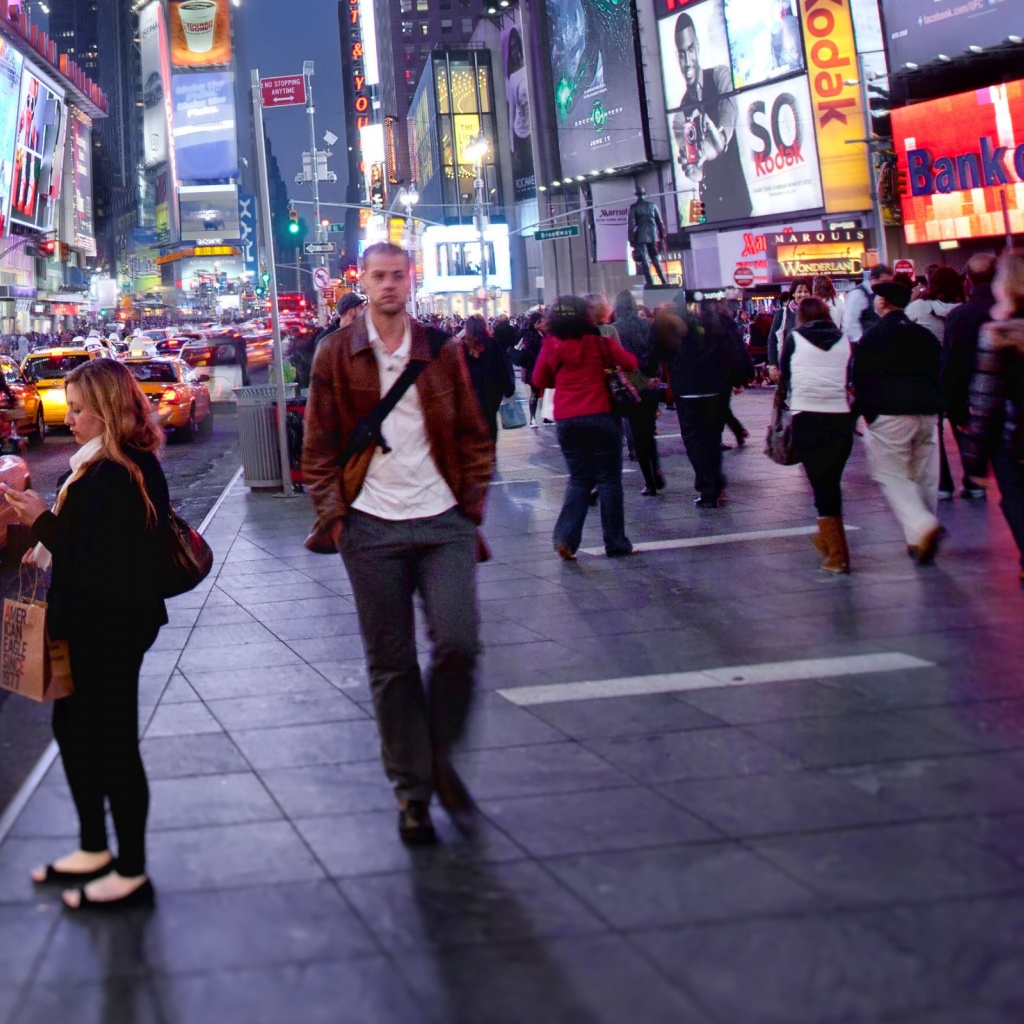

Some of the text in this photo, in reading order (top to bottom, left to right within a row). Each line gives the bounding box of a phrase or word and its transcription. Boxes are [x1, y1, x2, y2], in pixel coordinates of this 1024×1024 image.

[271, 87, 295, 95] ANYTIME
[274, 78, 301, 88] STOPPING
[596, 107, 623, 118] ANTERN
[749, 92, 802, 162] SO
[589, 138, 603, 147] JUNE
[754, 143, 805, 178] Kodak
[907, 136, 1008, 197] Bank
[540, 229, 572, 239] Broadway
[775, 230, 865, 244] MARQUIS
[780, 259, 864, 277] WONDERLAND
[4, 604, 27, 625] AMER
[3, 620, 23, 640] ICAN
[2, 636, 27, 657] EAGLE
[2, 653, 26, 676] SINCE
